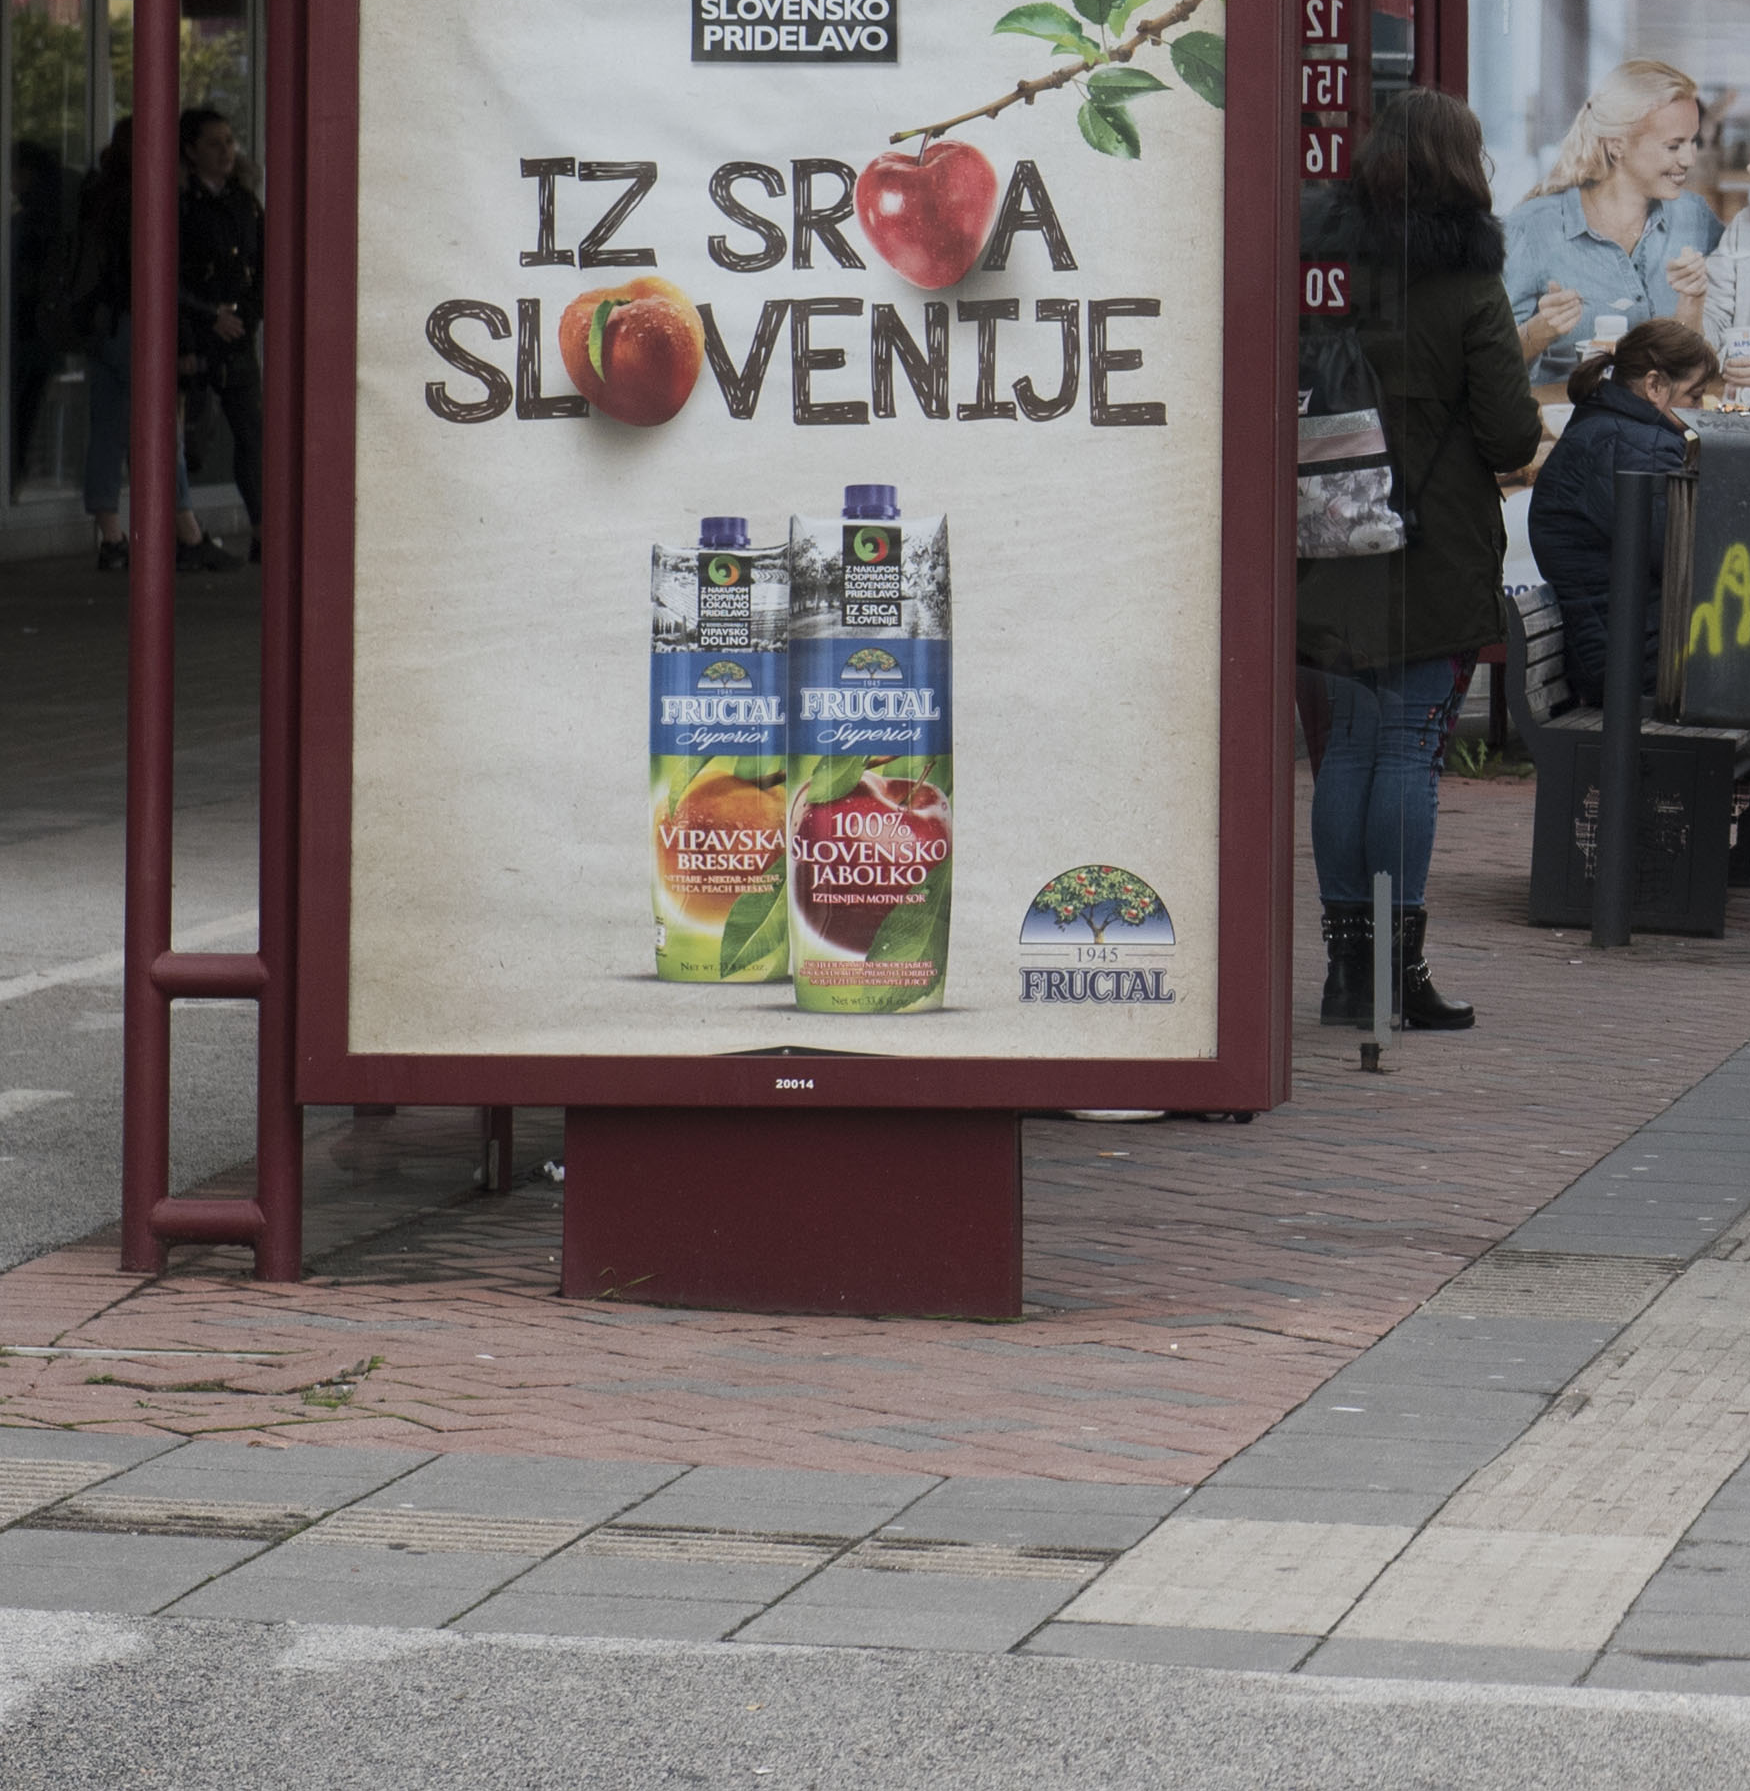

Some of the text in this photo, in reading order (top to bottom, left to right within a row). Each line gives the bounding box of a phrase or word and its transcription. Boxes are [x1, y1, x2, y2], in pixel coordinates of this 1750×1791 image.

[703, 25, 889, 51] PRIDELAVO
[519, 156, 658, 269] IZ
[701, 601, 749, 609] LOKALNO
[845, 590, 899, 599] PRIDELAVO
[701, 610, 749, 618] PRIDELAVO
[846, 605, 898, 615] IZ SRCA
[846, 616, 899, 626] SLOVENIJE
[701, 628, 749, 637] VIPAVSKO
[701, 637, 749, 646] DOLINO
[661, 696, 785, 725] FRUCTAL
[801, 688, 940, 721] FRUCTAL
[676, 726, 769, 751] Superior
[817, 723, 923, 750] Superior
[831, 811, 911, 839] 100%
[659, 825, 785, 851] VIPAVSKA
[791, 834, 947, 864] SLOVENSKO
[677, 853, 770, 871] BRESKEV
[812, 864, 927, 888] JABOLKO
[812, 893, 865, 904] IZTISNJEN
[866, 893, 903, 903] MOTNI
[1077, 947, 1119, 963] 1945
[1019, 966, 1176, 1003] FRUCTAL
[775, 1078, 815, 1091] 20014
